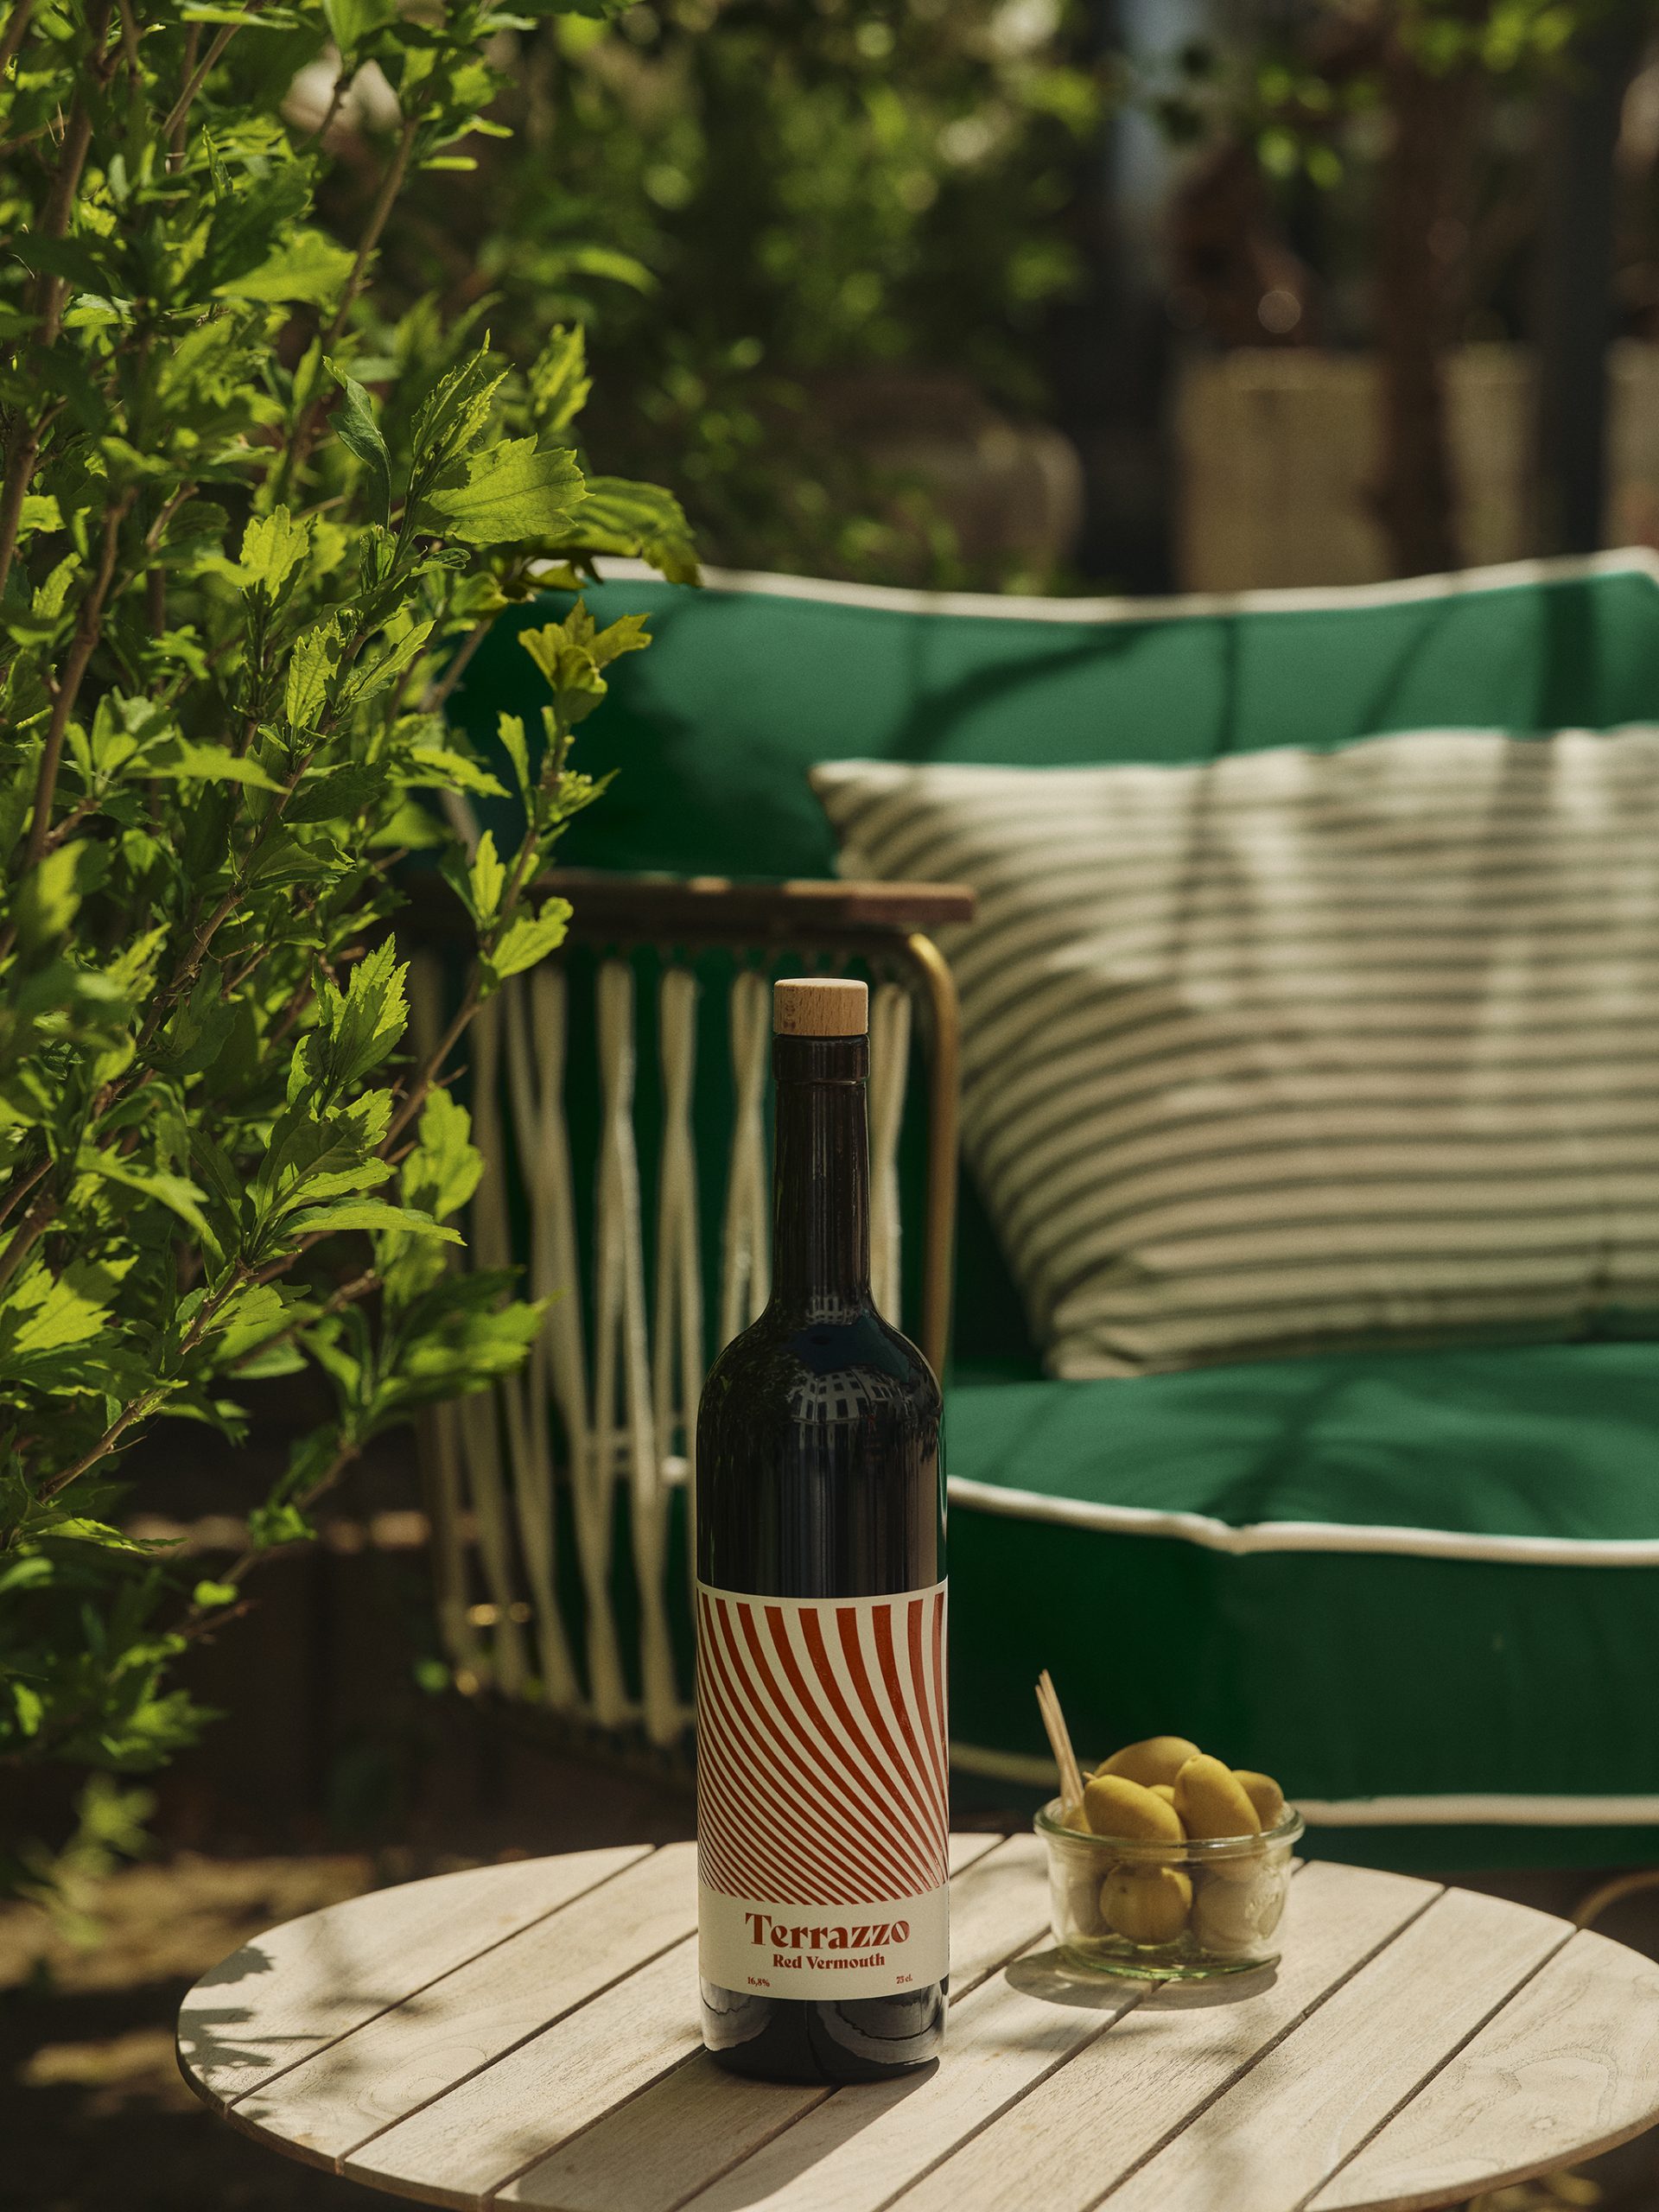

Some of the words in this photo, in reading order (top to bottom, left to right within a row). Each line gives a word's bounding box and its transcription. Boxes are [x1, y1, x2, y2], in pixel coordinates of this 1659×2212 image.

[746, 1912, 911, 1949] Terrazzo
[772, 1954, 802, 1968] Red
[807, 1953, 885, 1969] Vermouth
[747, 1976, 770, 1987] 16,8%
